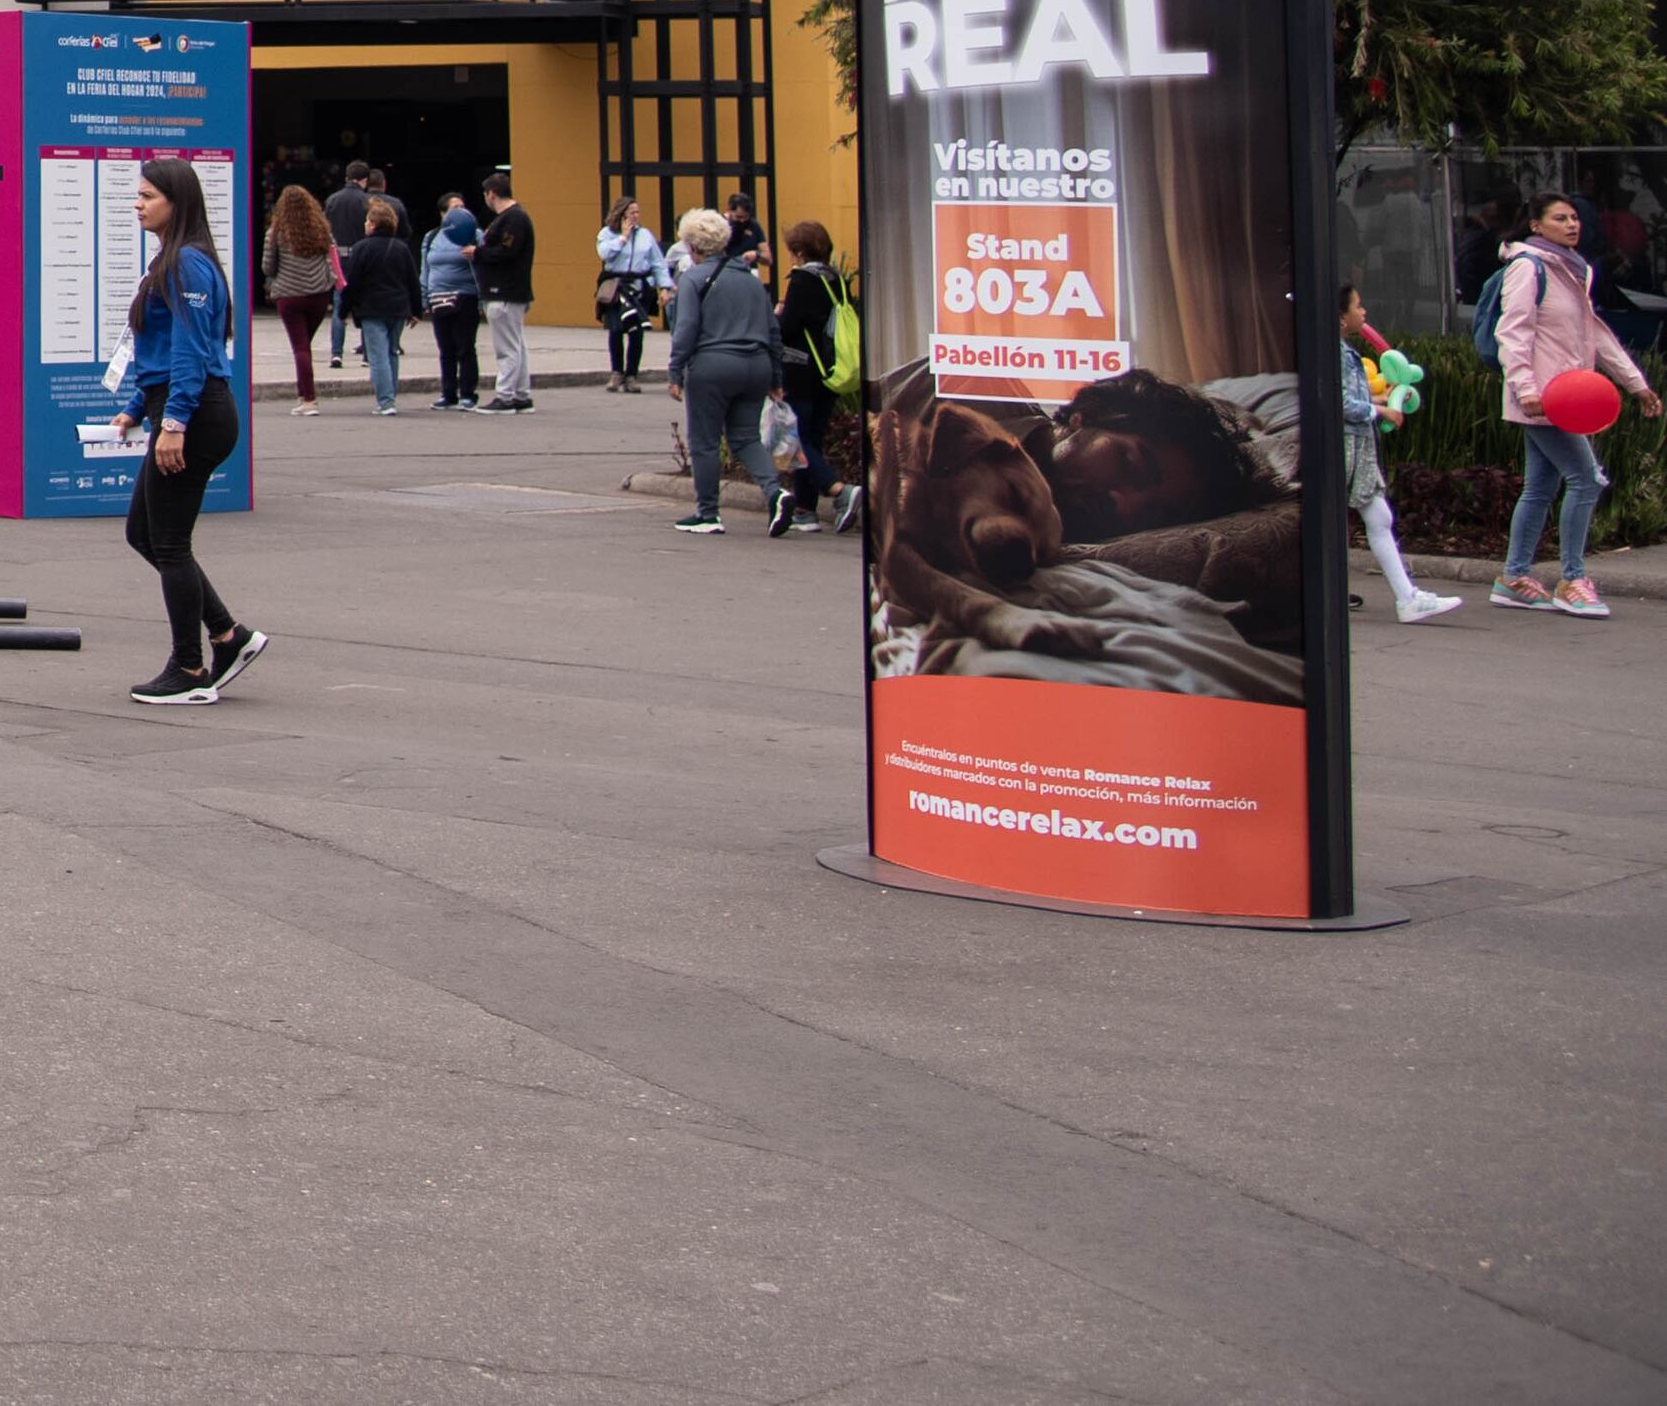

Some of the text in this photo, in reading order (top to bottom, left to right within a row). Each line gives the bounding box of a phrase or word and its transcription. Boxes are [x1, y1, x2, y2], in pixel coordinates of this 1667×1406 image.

[67, 82, 75, 94] EN
[77, 82, 86, 94] LA
[87, 83, 106, 95] FERIA
[108, 84, 120, 96] DEL
[121, 84, 144, 97] HOGAR
[78, 68, 95, 80] CLUB
[116, 69, 150, 82] RECONOCE
[162, 70, 195, 84] FIDELIDAD
[934, 139, 1112, 174] Visítanos
[935, 173, 1115, 199] en nuestro
[966, 233, 1068, 262] Stand
[943, 267, 1104, 317] 803A
[934, 343, 1121, 373] Pabellón 11-16
[901, 740, 1211, 791] Encuéntralos en puntos de venta Romance Relax
[890, 753, 942, 777] distribuidores
[943, 767, 996, 786] marcados
[998, 777, 1022, 790] con
[1024, 778, 1037, 792] la
[1039, 782, 1124, 804] promoción,
[1127, 790, 1161, 804] más
[1164, 792, 1258, 811] información
[909, 789, 1198, 850] romancerelax.com
